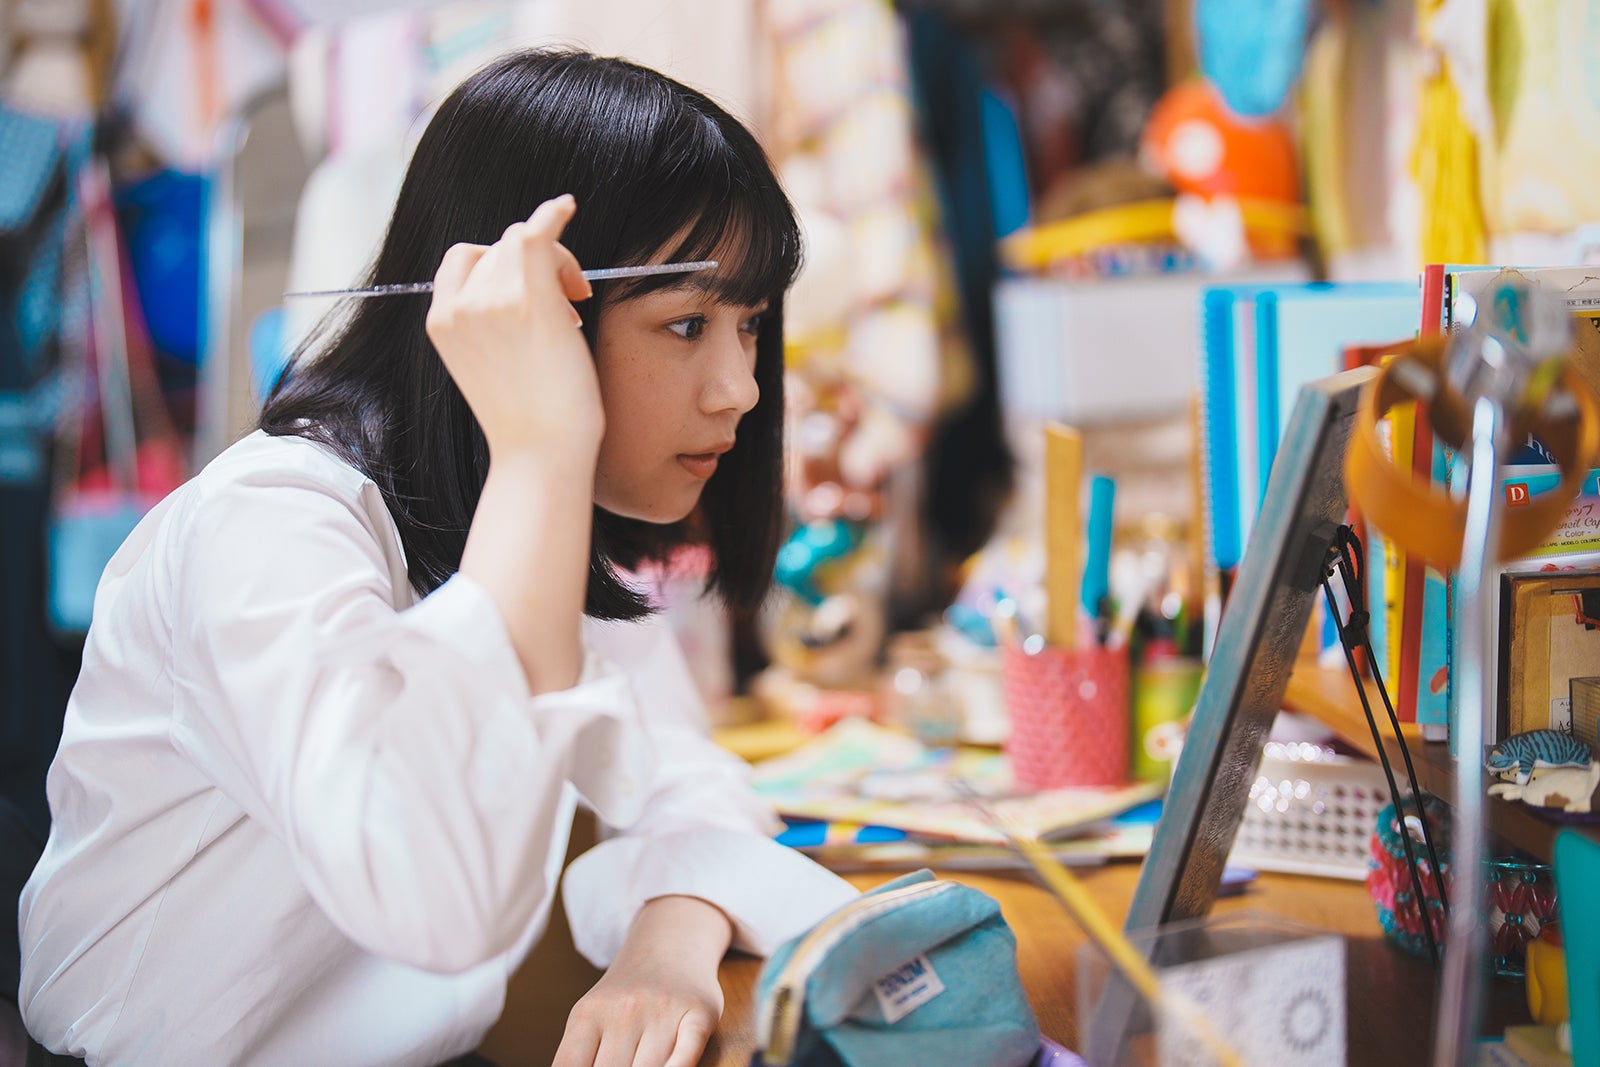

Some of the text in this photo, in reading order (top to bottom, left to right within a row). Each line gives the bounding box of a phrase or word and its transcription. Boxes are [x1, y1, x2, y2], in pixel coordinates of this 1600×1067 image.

[1510, 486, 1525, 502] D
[1565, 503, 1594, 517] ャップ
[1556, 518, 1581, 529] encil
